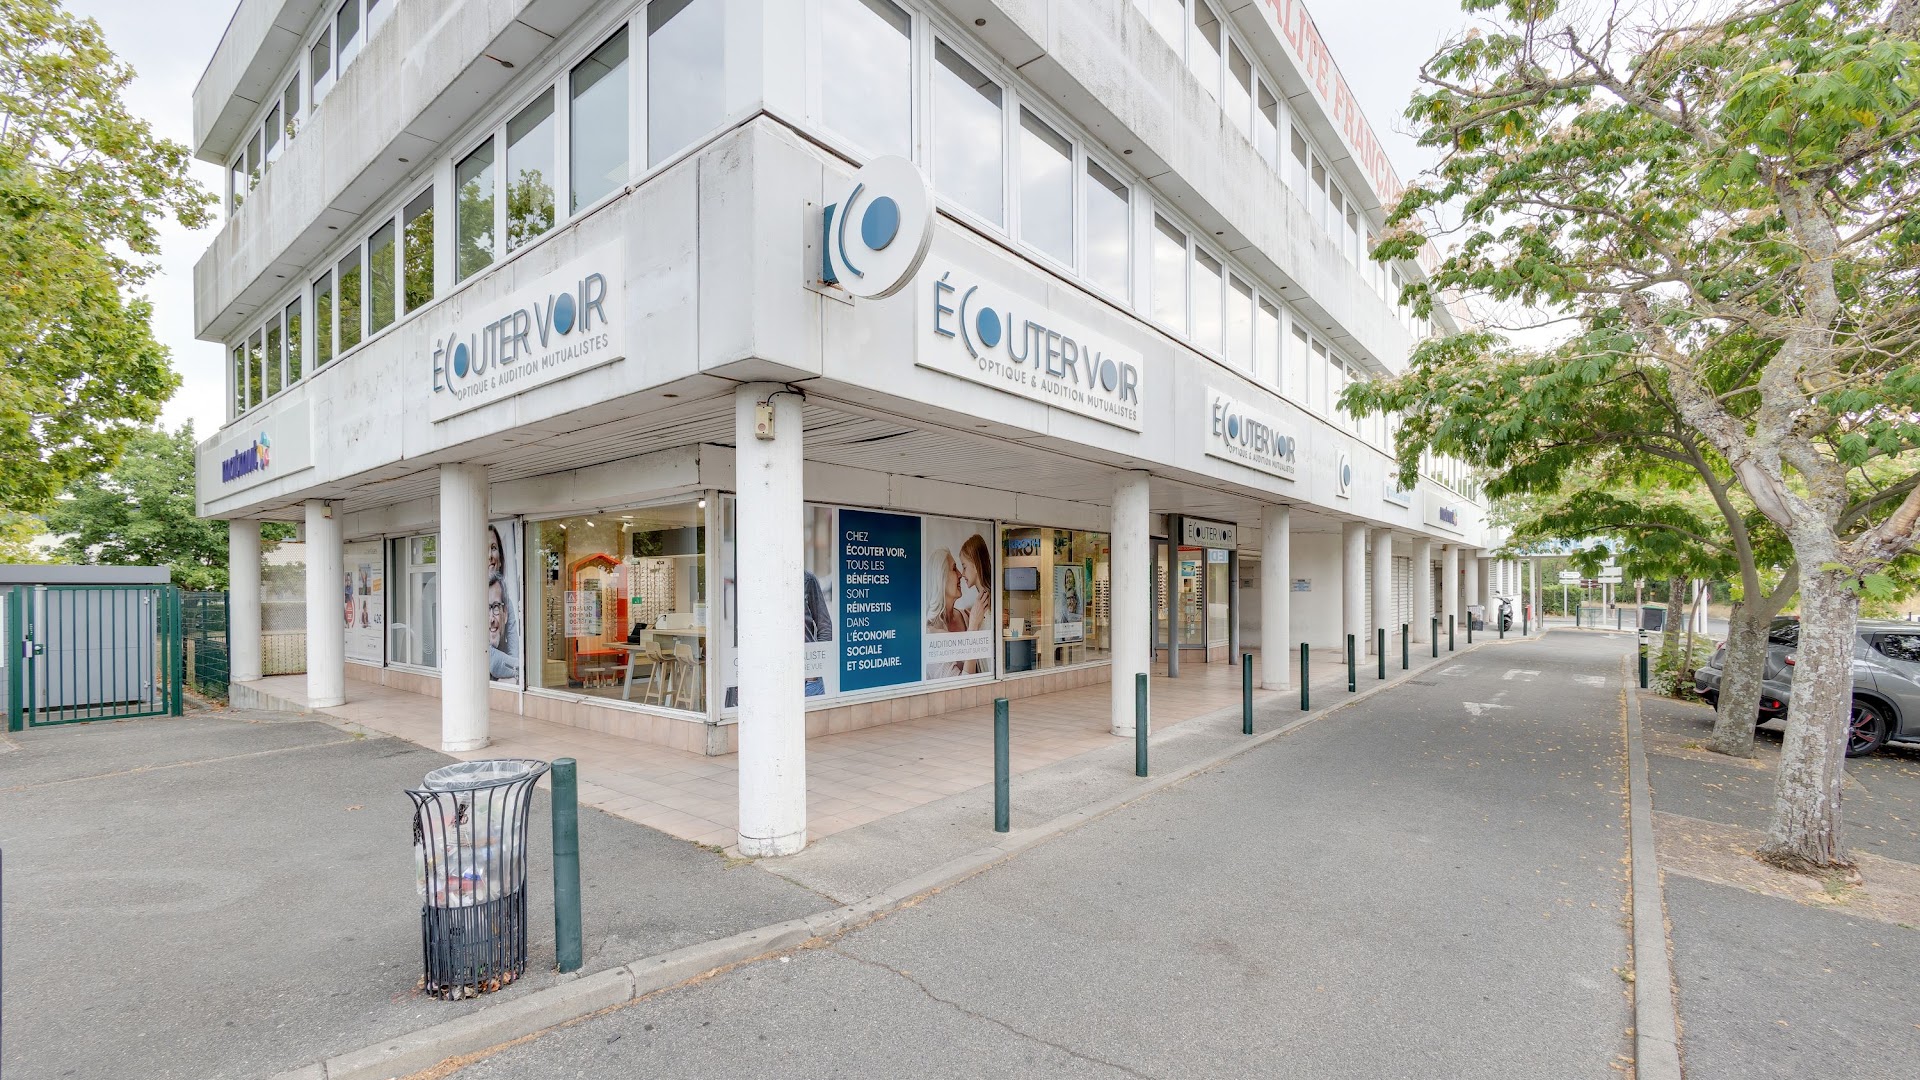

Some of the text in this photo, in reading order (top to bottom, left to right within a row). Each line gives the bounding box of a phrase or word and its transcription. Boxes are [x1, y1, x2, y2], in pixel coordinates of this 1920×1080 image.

[1333, 73, 1402, 203] FRANÇAI
[433, 272, 608, 395] ÉCOUTER VOIR
[933, 271, 1138, 405] ÉCOUTER VOIR
[457, 333, 609, 401] OPTIQUE & AUDITION MUTUALISTES
[978, 357, 1137, 421] OPTIQUE & AUDITION MUTUALISTES
[1213, 396, 1296, 464] ÉCOUTER VOIR
[1228, 445, 1247, 460] OPTIQUE
[1272, 460, 1295, 474] MUTUALISTES
[846, 530, 869, 542] CHEZ
[1188, 521, 1233, 543] ÉCOUTER VOIR
[846, 543, 907, 559] ÉCOUTER VOIR,
[846, 559, 885, 571] TOUS LES
[846, 572, 890, 585] BÉNÉFICES
[846, 588, 870, 599] SONT
[846, 600, 892, 614] RÉINVESTIS
[846, 617, 870, 628] DANS
[846, 629, 896, 642] L'ÉCONOMIE
[929, 636, 989, 649] AUDITION MUTUALISTE
[804, 650, 826, 661] LISTE
[846, 644, 883, 657] SOCIALE
[847, 656, 902, 671] ET SOLIDAIRE.
